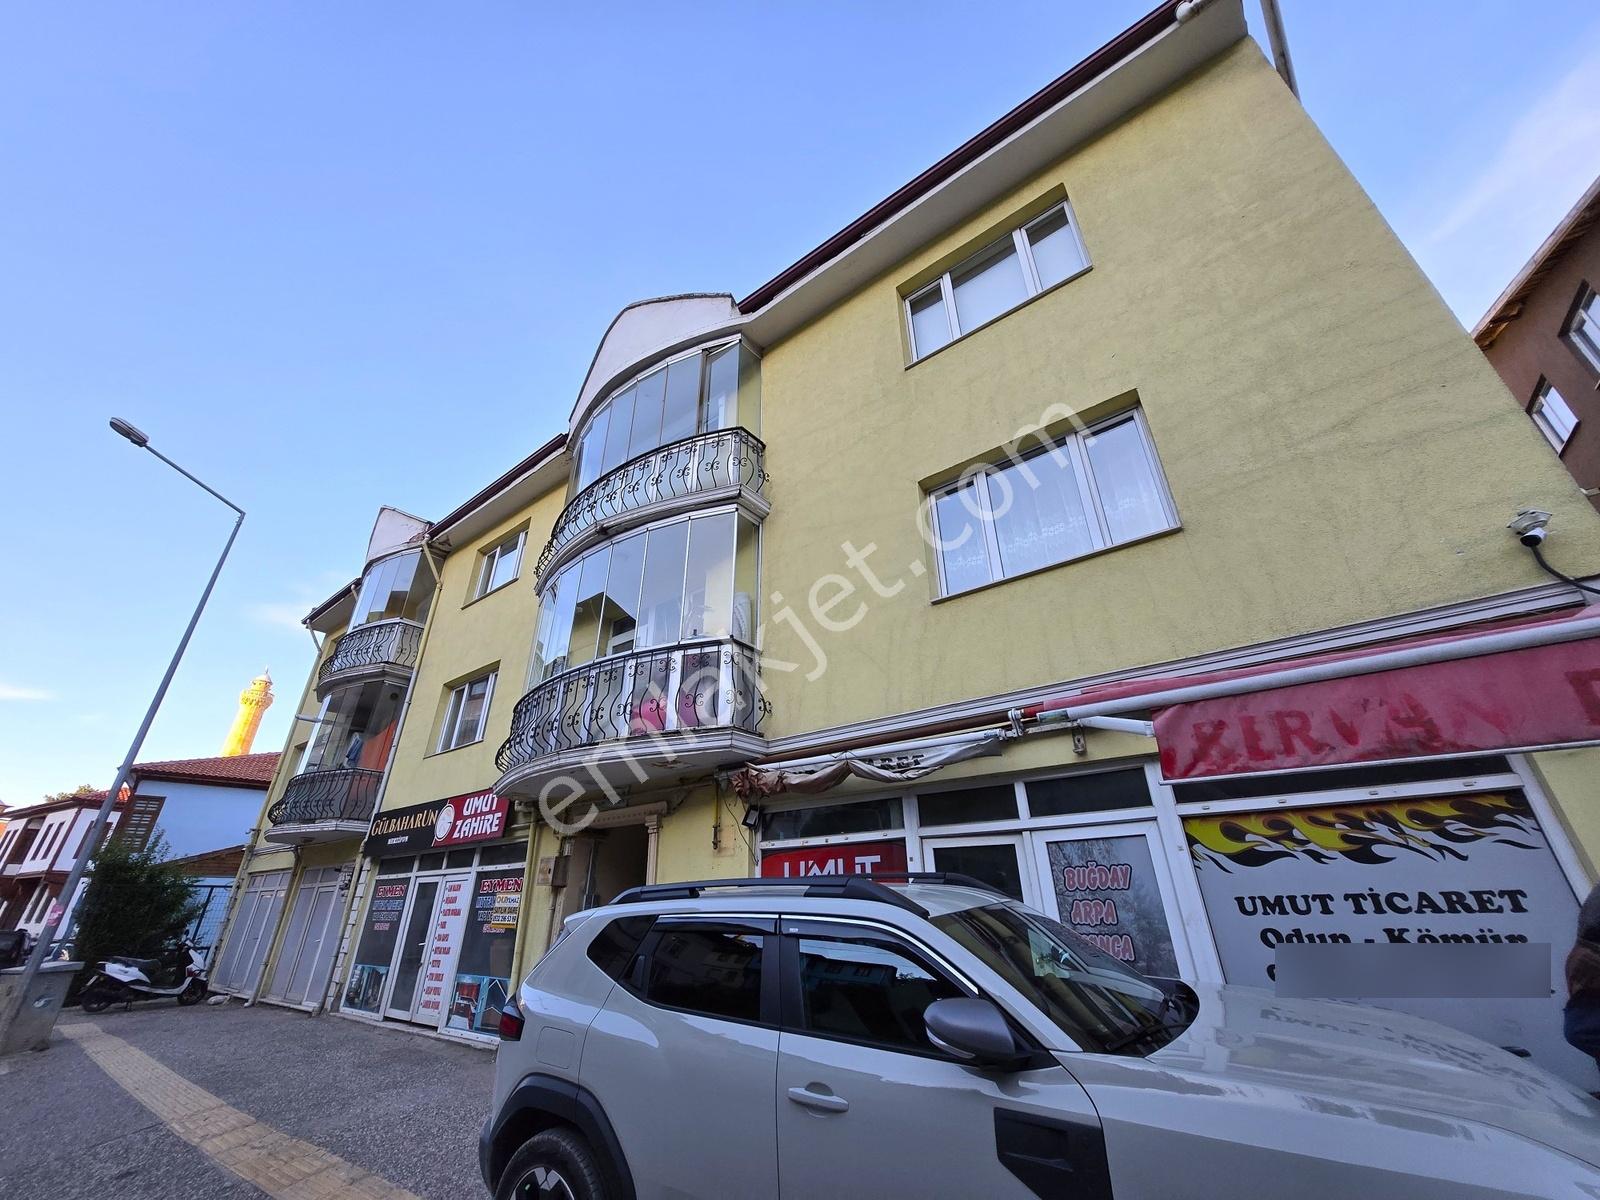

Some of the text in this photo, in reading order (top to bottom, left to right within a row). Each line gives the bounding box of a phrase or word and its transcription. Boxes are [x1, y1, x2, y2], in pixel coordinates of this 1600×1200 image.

[463, 794, 498, 815] UMUT
[480, 877, 524, 893] EYMEN
[1064, 861, 1132, 891] BUĞDAY
[376, 884, 407, 898] EYMEN
[1234, 887, 1529, 916] UMUT TİCARET
[1071, 899, 1119, 927] ARPA
